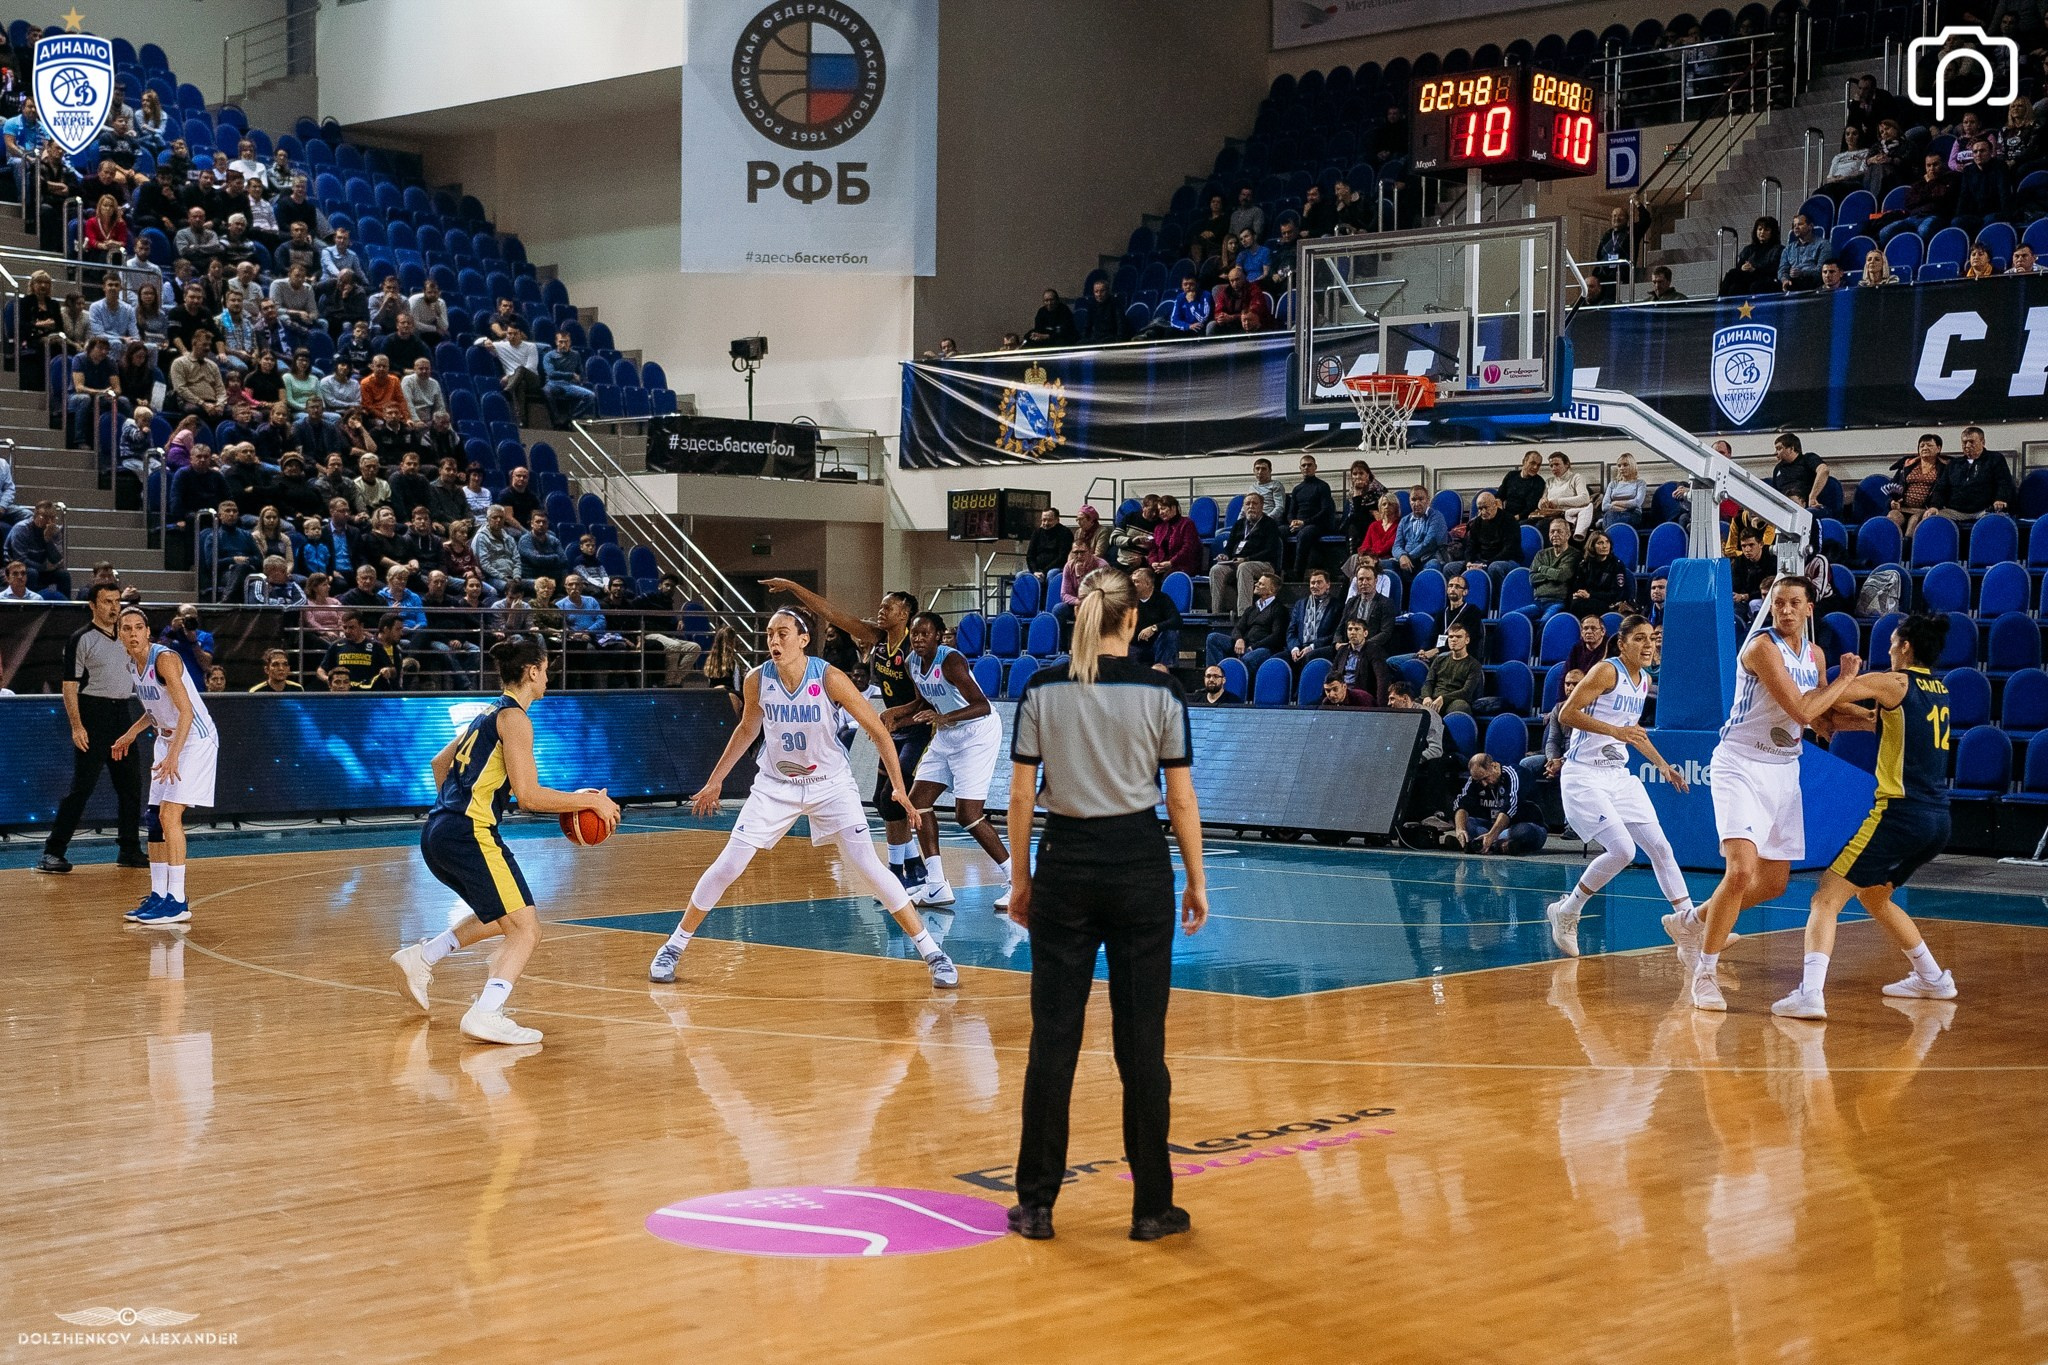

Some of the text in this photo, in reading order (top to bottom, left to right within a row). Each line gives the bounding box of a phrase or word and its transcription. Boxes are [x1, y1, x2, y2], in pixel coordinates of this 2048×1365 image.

[740, 4, 878, 135] РОССИЙСКАЯ ФЕДЕРАЦИЯ БАСКЕТБОЛА
[791, 131, 827, 142] 1991
[1465, 106, 1512, 157] 10
[1562, 116, 1593, 165] 10
[1610, 136, 1636, 145] ТРИБУНА
[1609, 146, 1637, 184] D
[747, 160, 871, 205] РФБ
[745, 251, 869, 265] #здесьбаскетбол
[1717, 330, 1772, 349] ДИНАМО
[1724, 392, 1757, 402] КУРСК
[668, 433, 796, 457] #здесьбаскетбол
[882, 680, 894, 697] 8
[765, 703, 821, 723] DYNAMO
[1926, 704, 1950, 751] 12
[781, 732, 807, 752] 30
